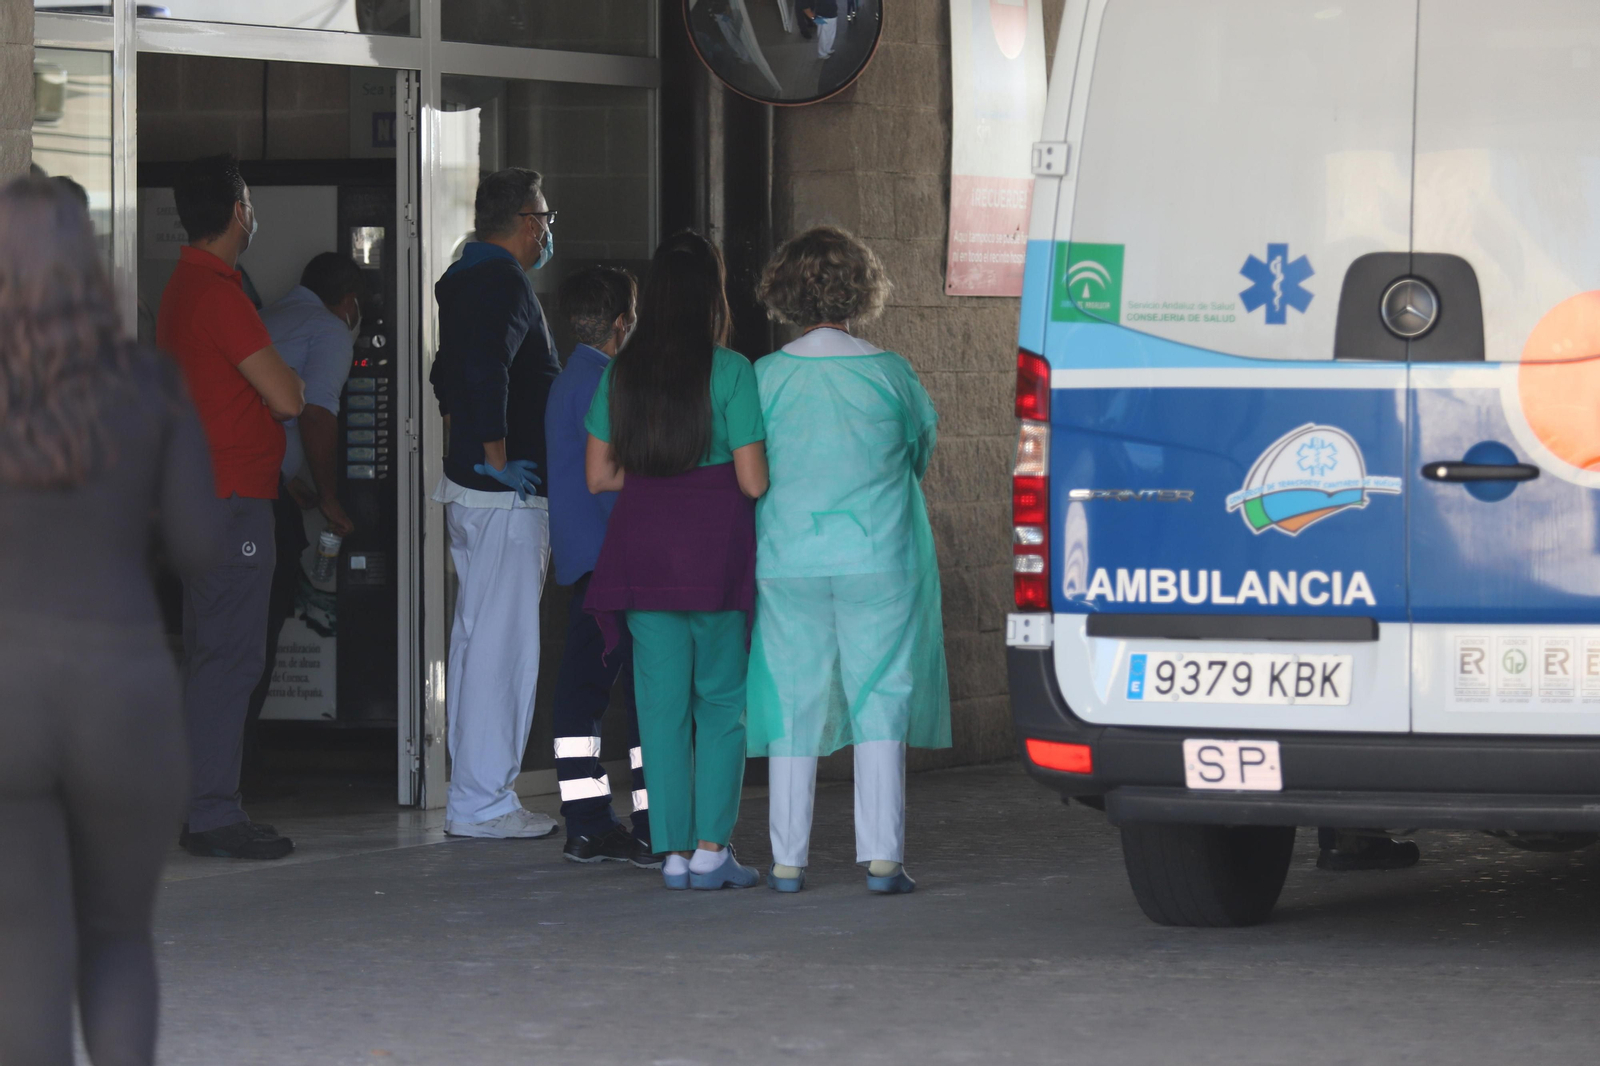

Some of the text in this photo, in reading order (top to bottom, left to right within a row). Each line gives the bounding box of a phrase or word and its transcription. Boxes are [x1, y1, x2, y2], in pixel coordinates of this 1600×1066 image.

[389, 85, 396, 99] p
[377, 118, 396, 142] N
[1127, 300, 1236, 311] Servicio Andaluz de Salud
[1126, 312, 1236, 323] CONSEJERIA DE SALUD
[1069, 488, 1194, 502] SPRINTER
[1086, 568, 1377, 606] AMBULANCIA
[288, 656, 298, 668] de
[299, 656, 321, 668] altura
[1155, 660, 1343, 698] 9379 KBK
[286, 685, 296, 698] de
[1131, 681, 1140, 692] E
[1197, 745, 1266, 784] SP
